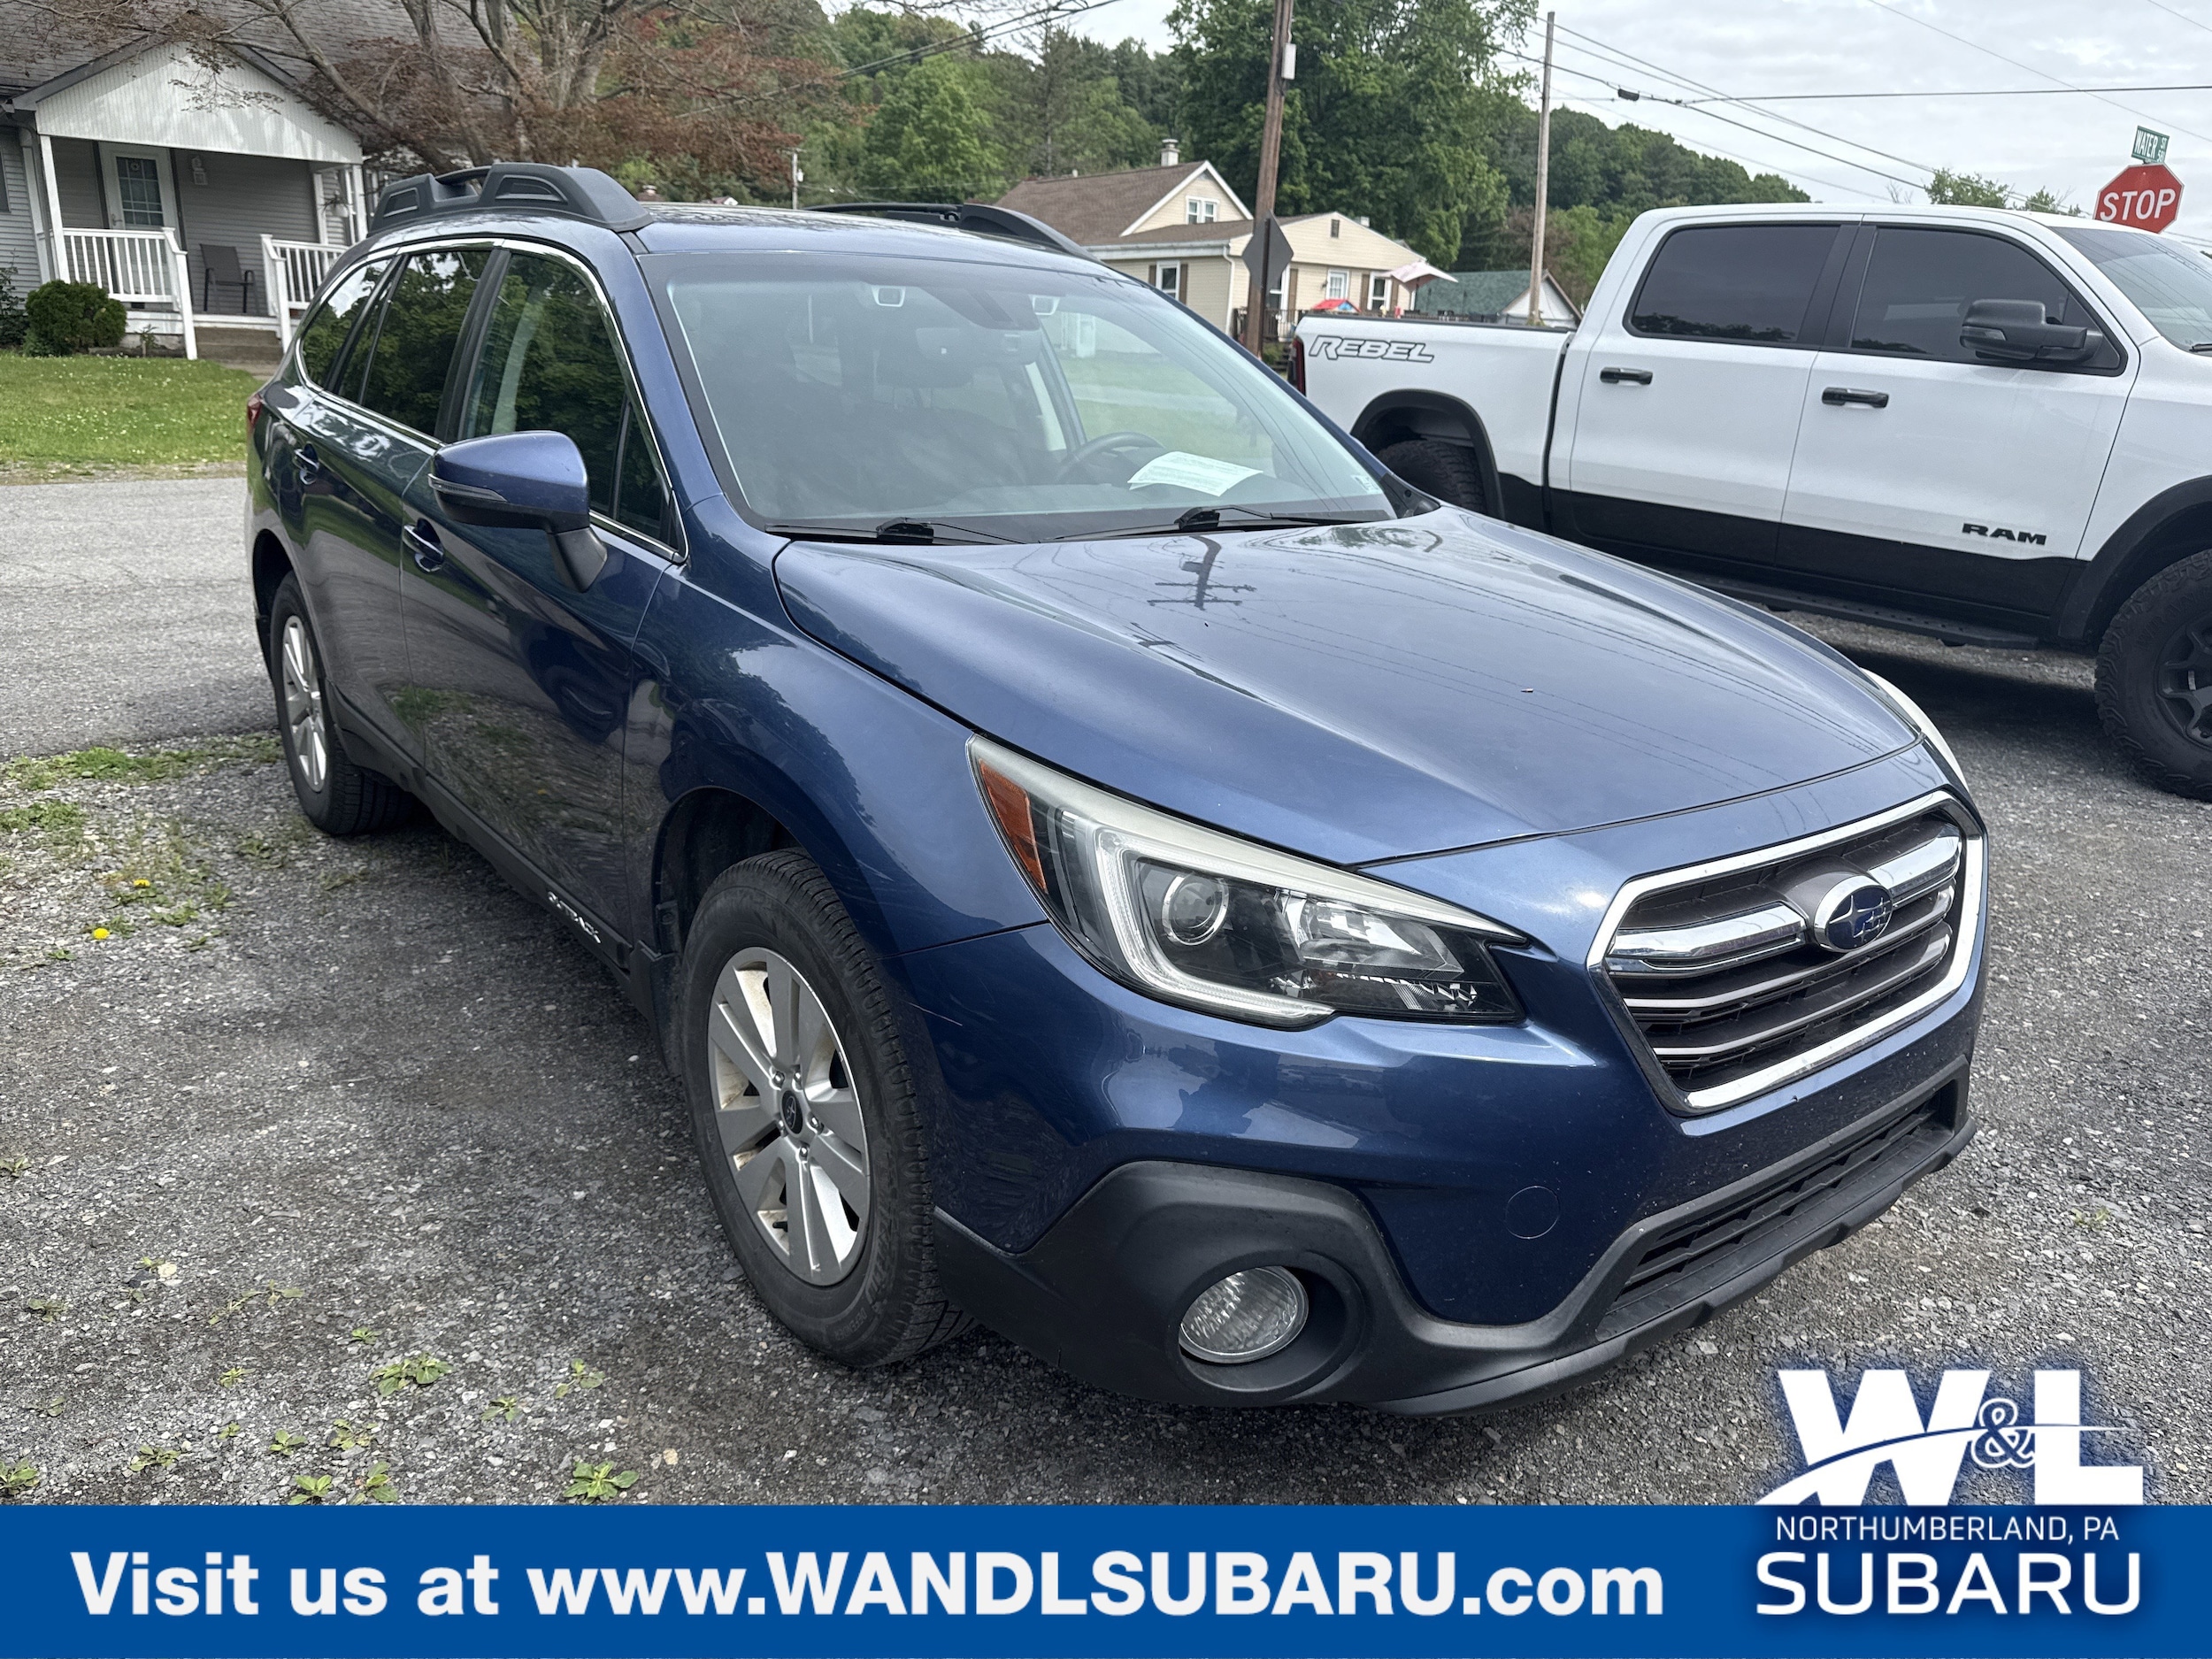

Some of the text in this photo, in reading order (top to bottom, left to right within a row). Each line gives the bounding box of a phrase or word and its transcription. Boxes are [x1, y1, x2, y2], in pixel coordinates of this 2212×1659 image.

[2134, 130, 2158, 158] WATER
[2160, 137, 2167, 150] ST
[2100, 188, 2177, 221] STOP
[1309, 334, 1435, 364] REBEL
[1962, 523, 2047, 546] RAM
